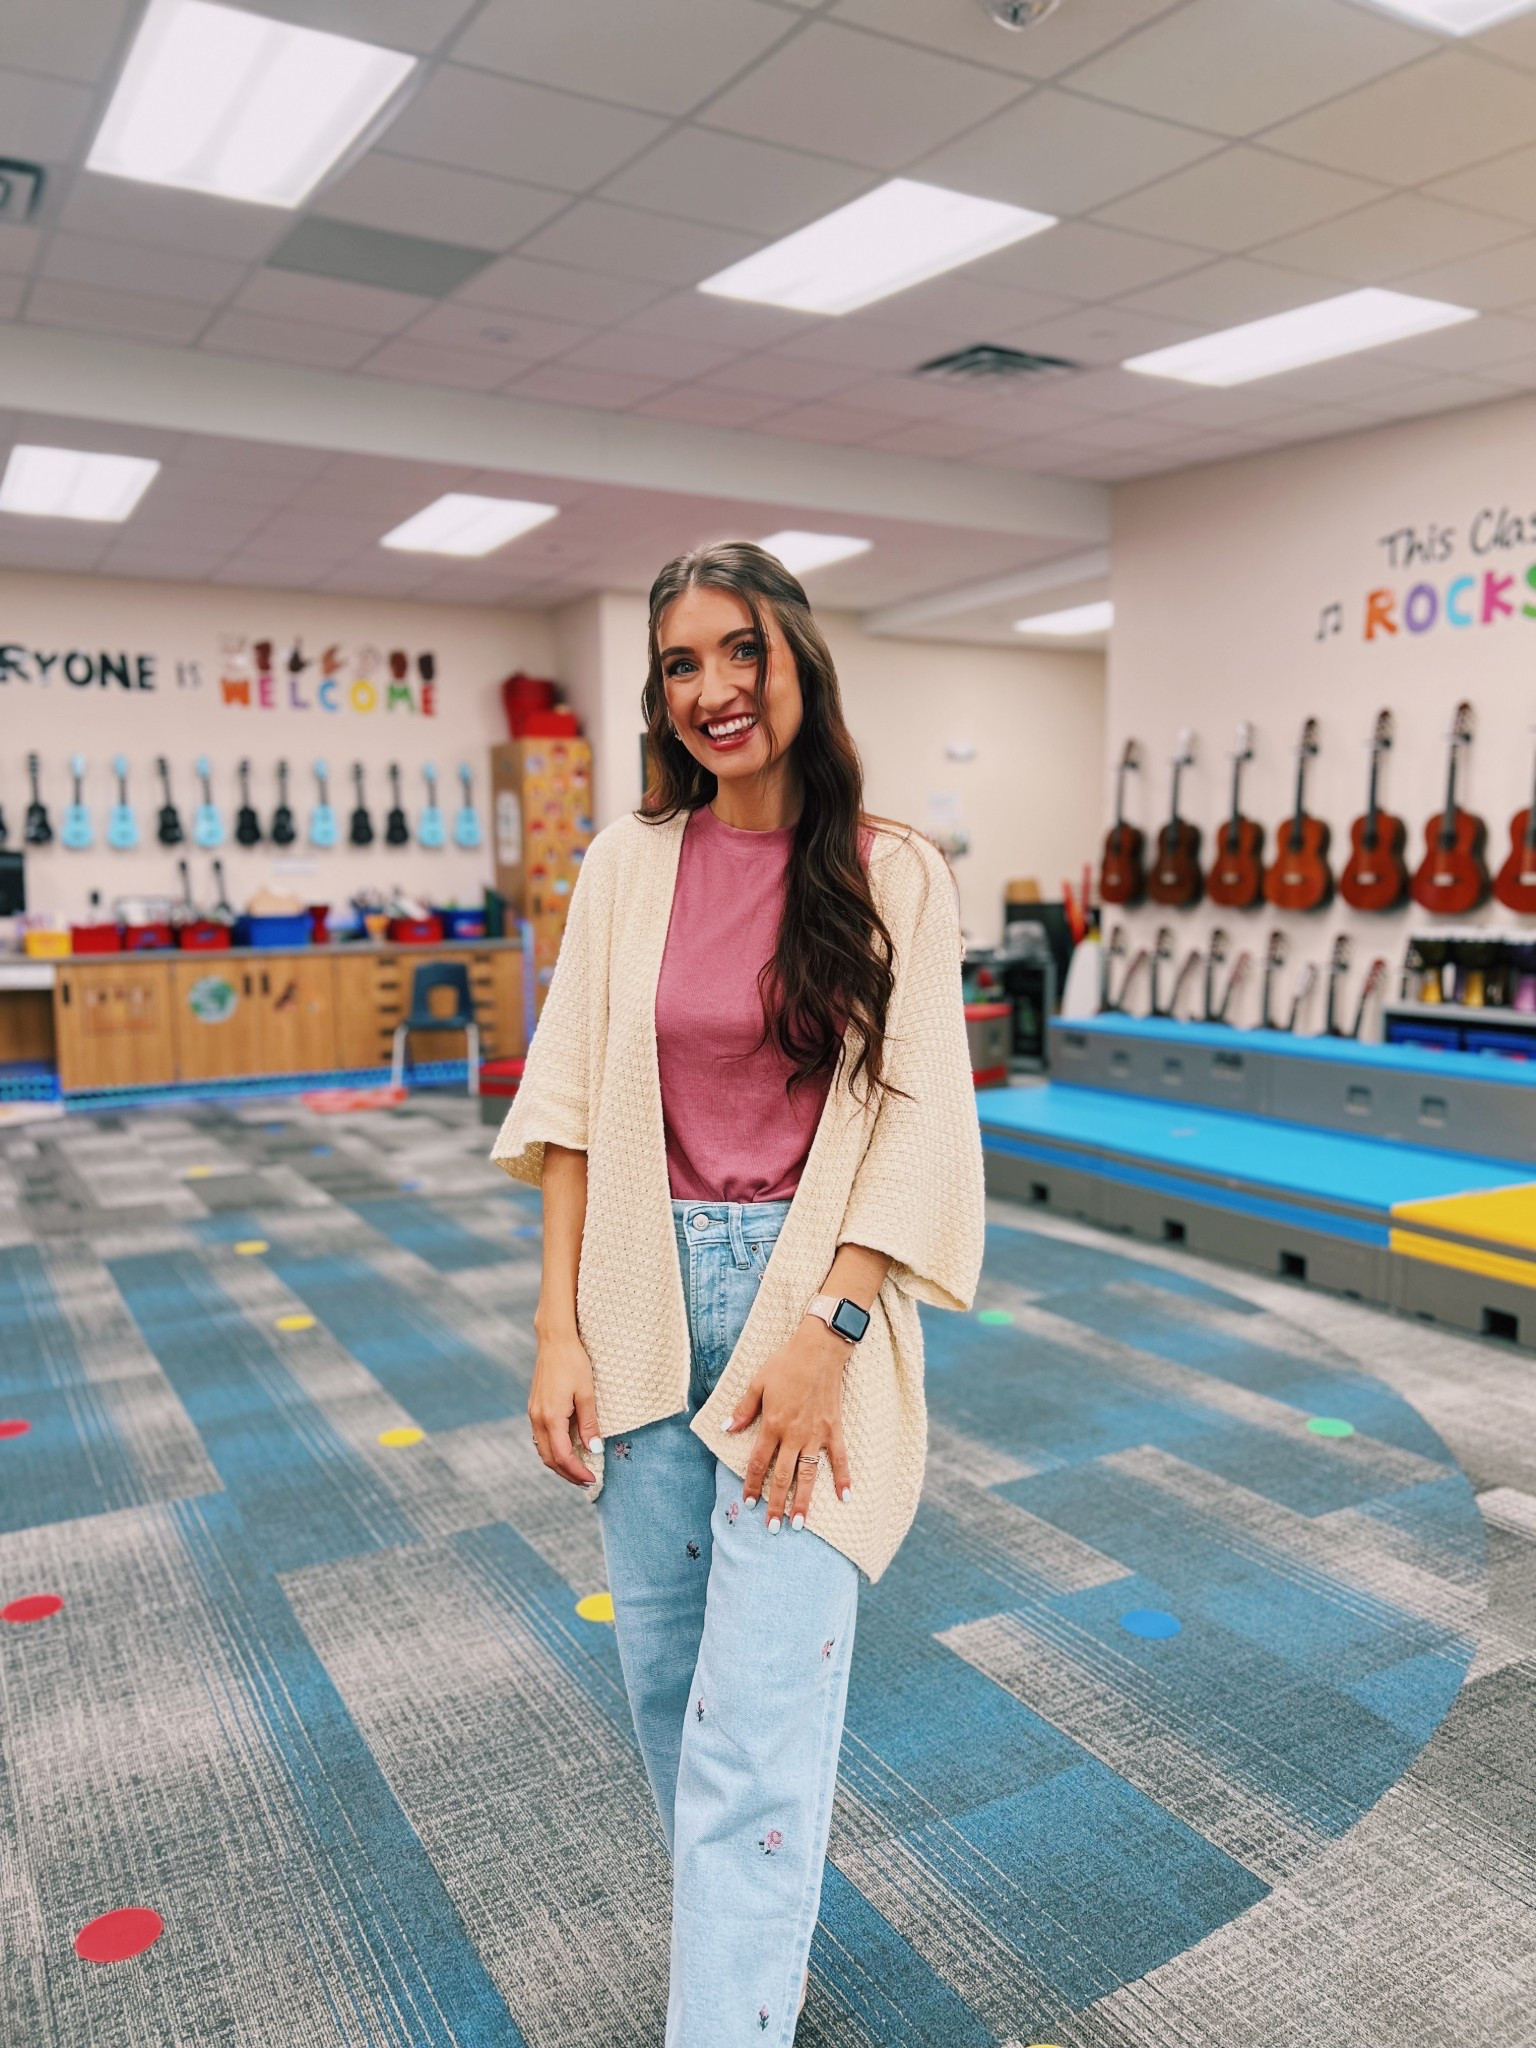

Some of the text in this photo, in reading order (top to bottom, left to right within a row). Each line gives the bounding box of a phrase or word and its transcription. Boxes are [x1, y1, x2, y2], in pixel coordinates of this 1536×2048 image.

[1379, 524, 1455, 568] This
[0, 645, 435, 716] RYONE IS WELCOME
